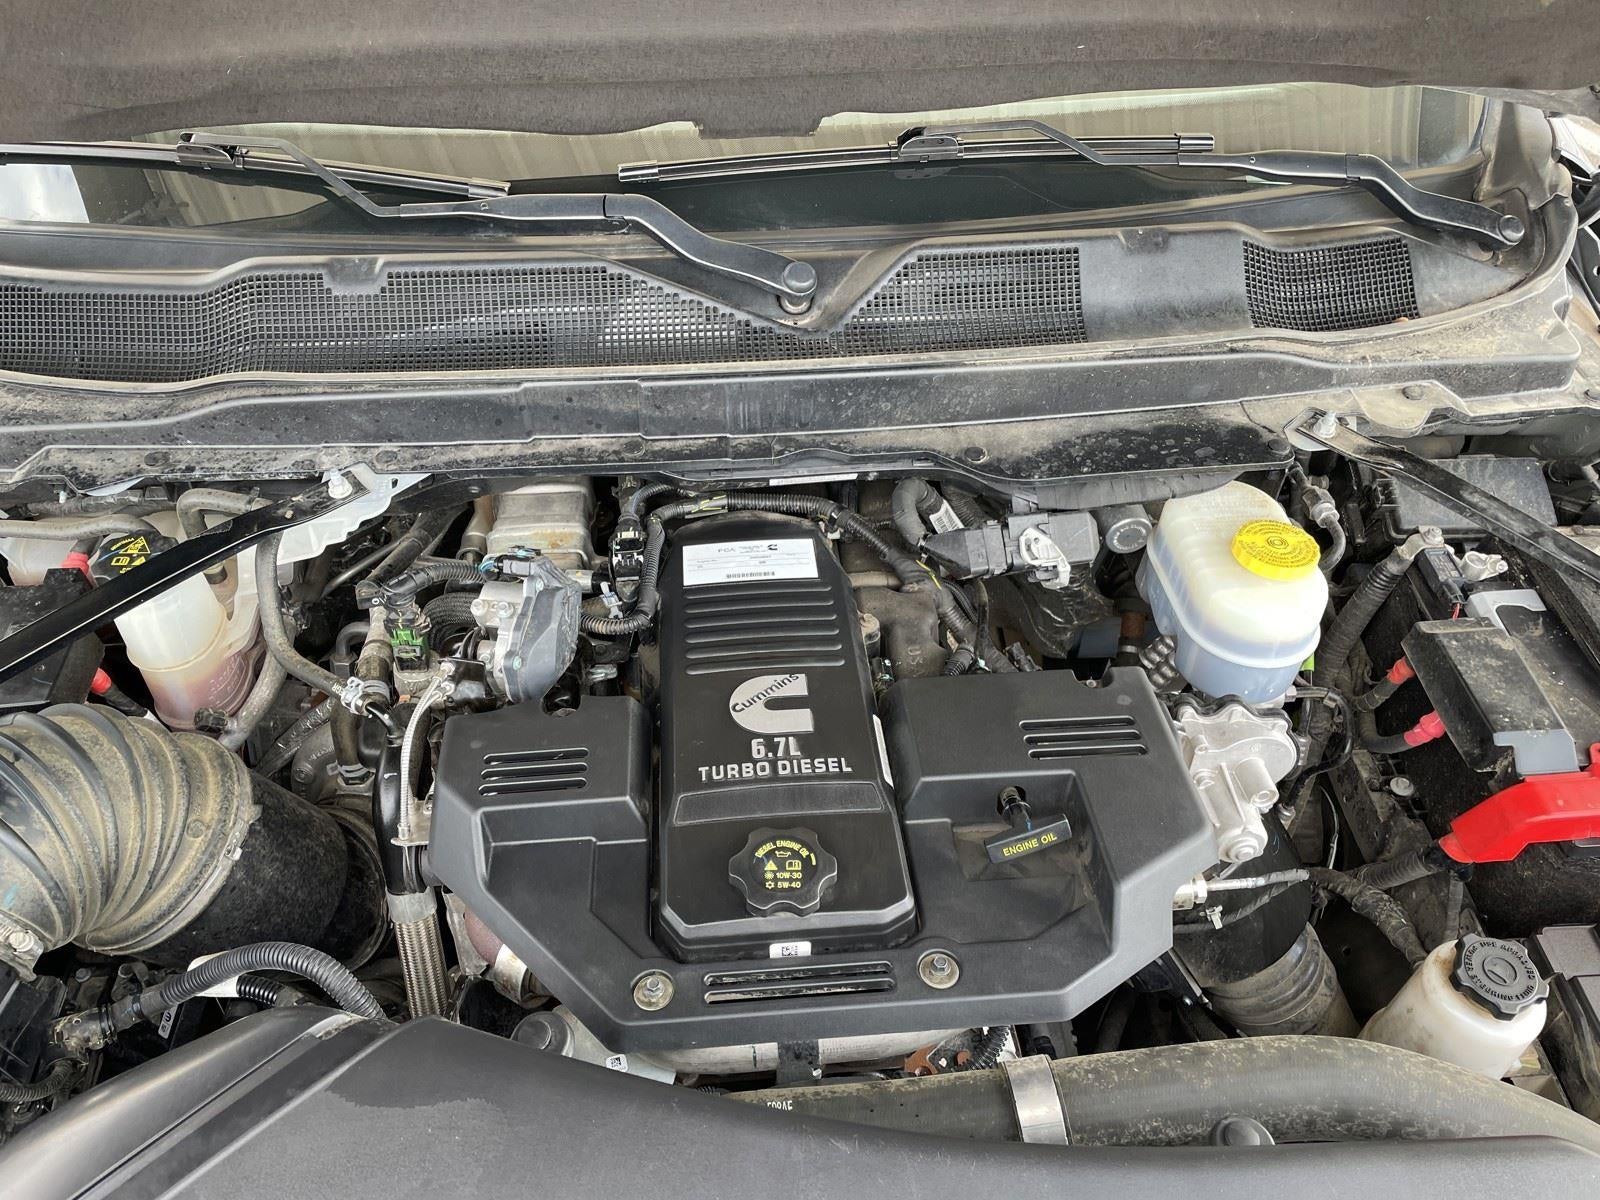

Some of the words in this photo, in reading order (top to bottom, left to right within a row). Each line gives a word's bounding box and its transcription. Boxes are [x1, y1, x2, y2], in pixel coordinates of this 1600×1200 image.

[731, 673, 800, 713] Cummins
[751, 736, 802, 759] 6.7L
[698, 761, 770, 781] TURBO
[777, 757, 853, 776] DIESEL
[755, 842, 776, 858] DIESEL
[776, 840, 802, 851] ENGINE
[799, 847, 810, 858] OIL
[1003, 839, 1039, 856] ENGINE
[1041, 833, 1058, 844] OIL
[777, 881, 802, 889] 5W-40
